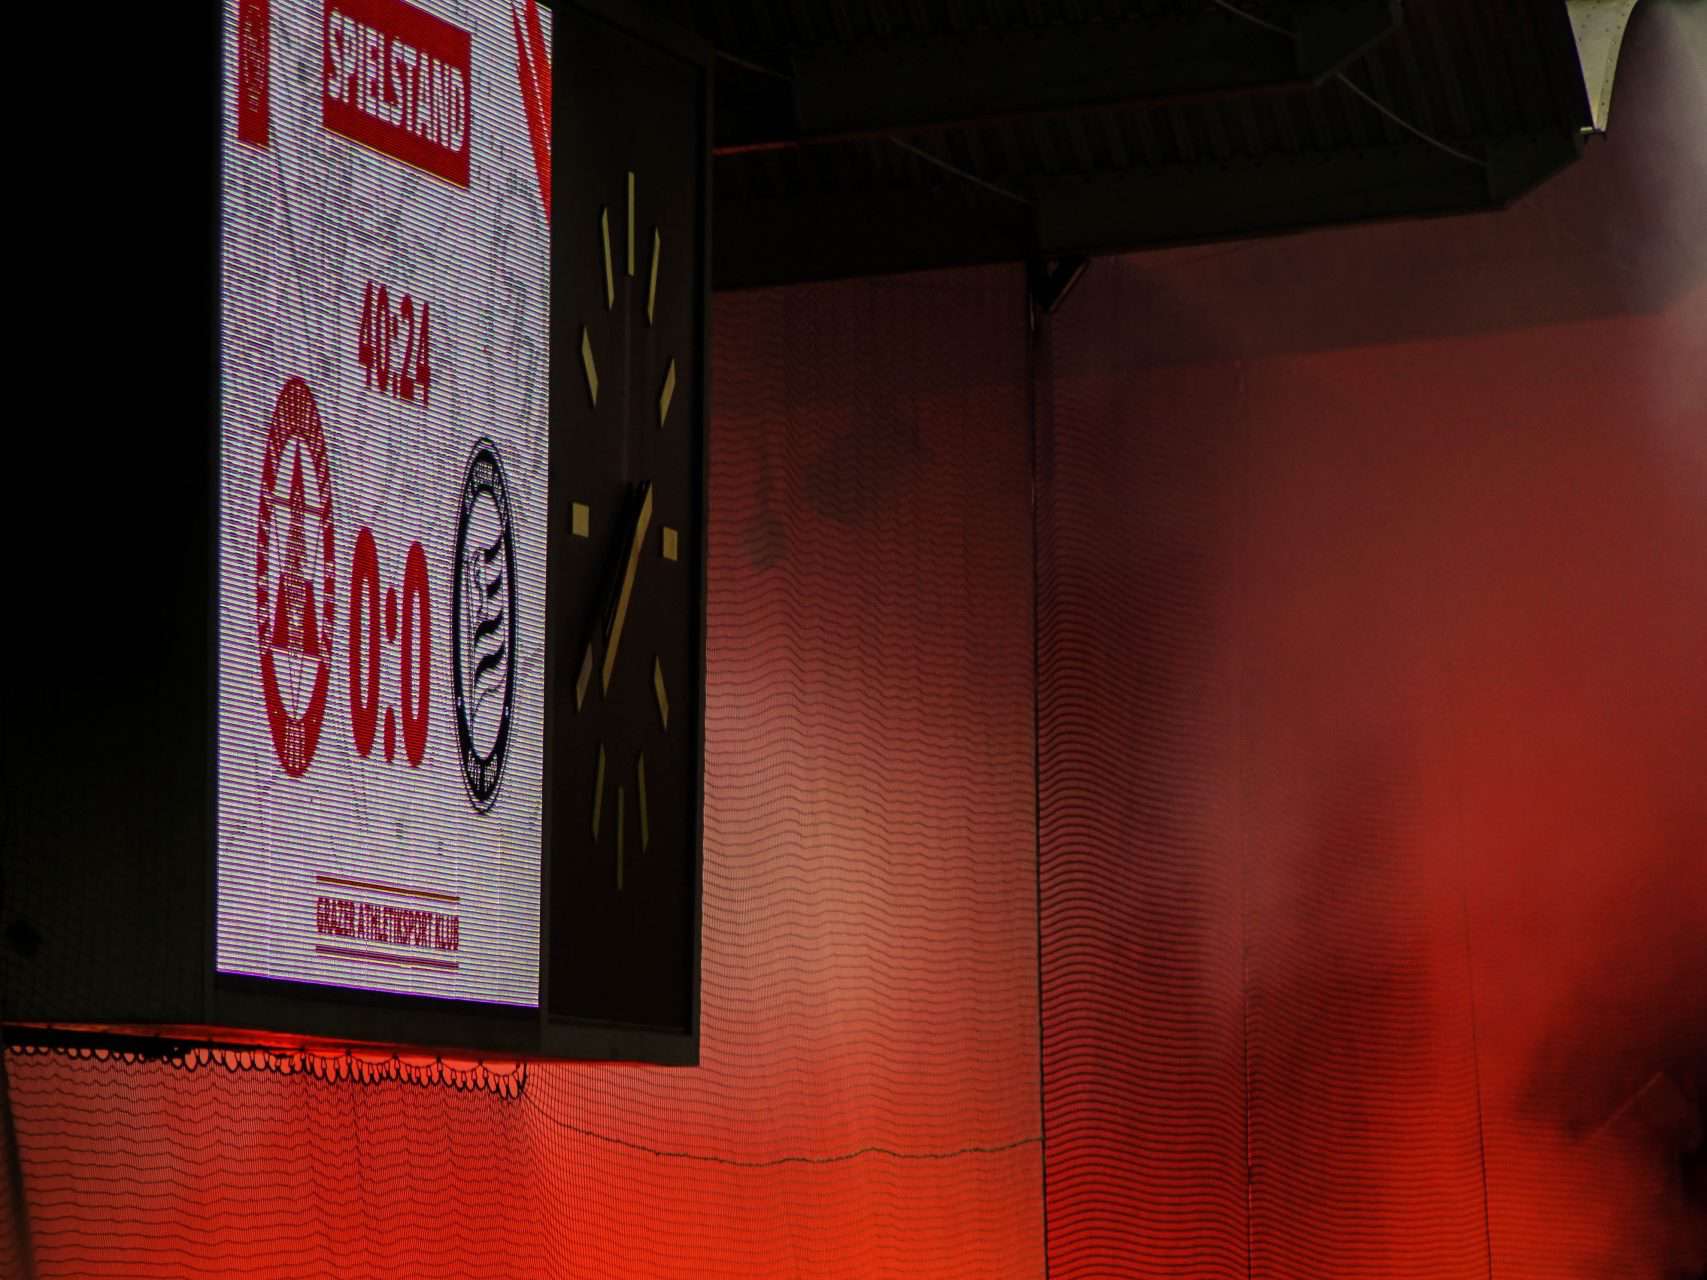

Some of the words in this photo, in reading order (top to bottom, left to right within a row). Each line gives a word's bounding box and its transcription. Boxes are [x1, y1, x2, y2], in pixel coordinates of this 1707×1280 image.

[328, 7, 465, 152] SPIELSTAND
[358, 279, 431, 409] 40:24
[349, 527, 430, 769] 0:0
